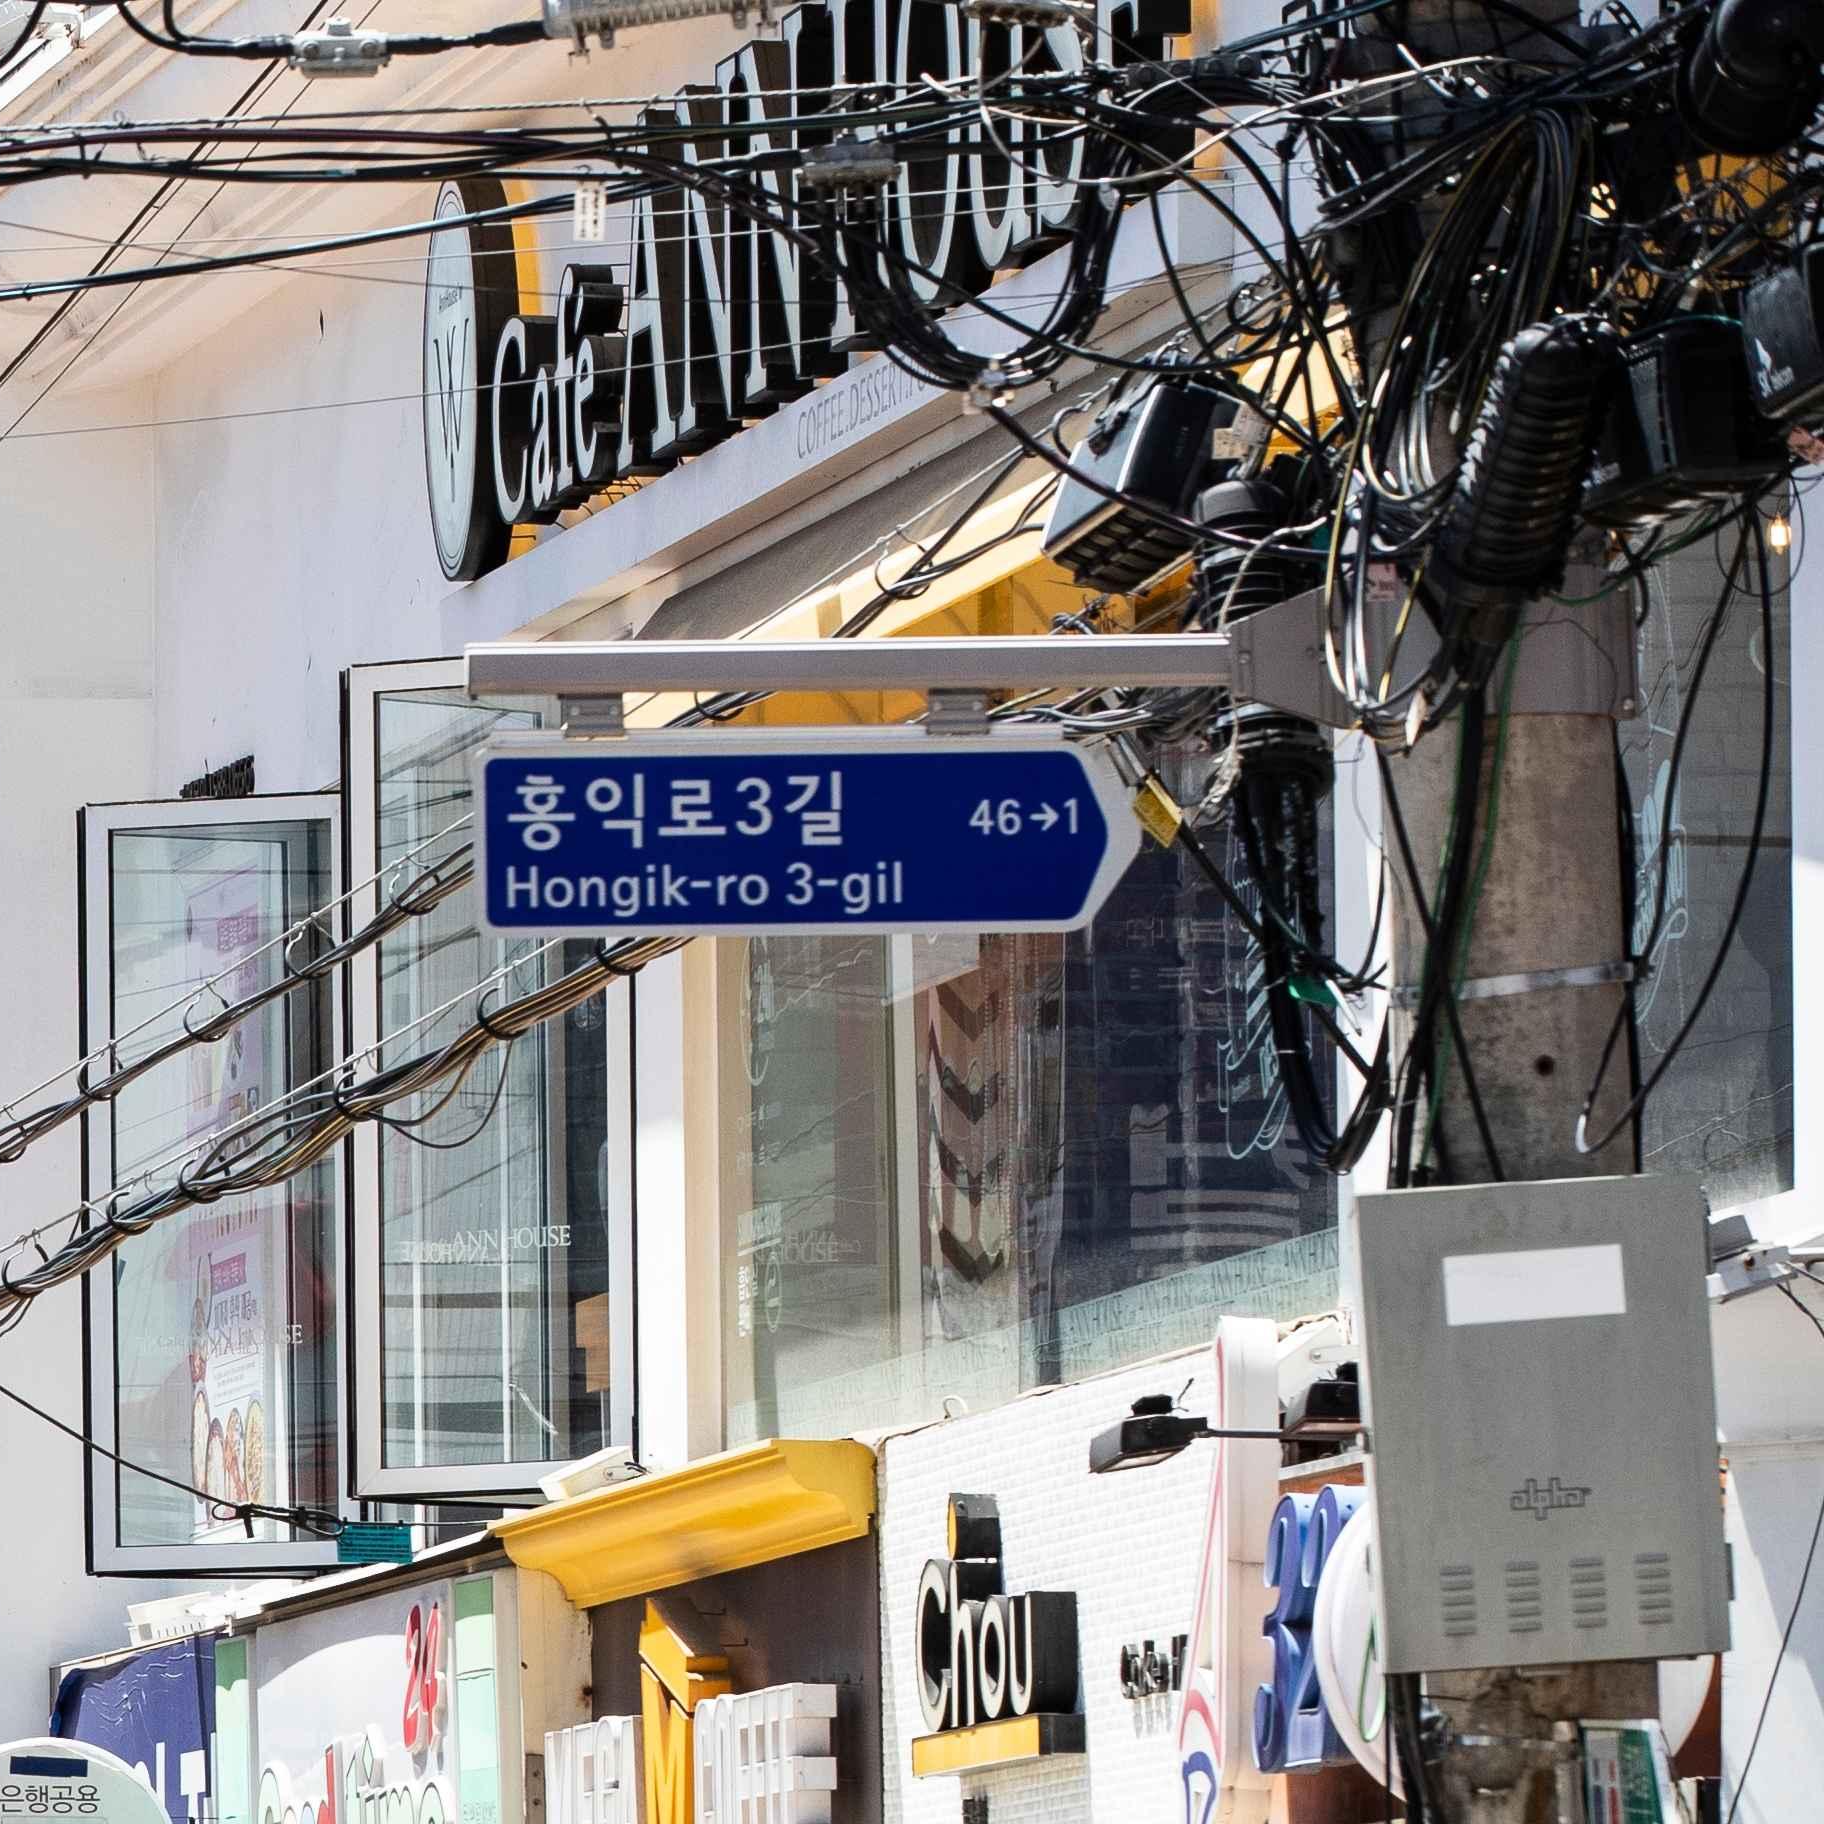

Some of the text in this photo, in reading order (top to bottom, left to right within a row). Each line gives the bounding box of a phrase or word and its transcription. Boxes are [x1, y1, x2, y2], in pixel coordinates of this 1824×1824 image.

[505, 768, 845, 850] 홍익로3길
[504, 858, 903, 917] Hongik-ro 3-gil
